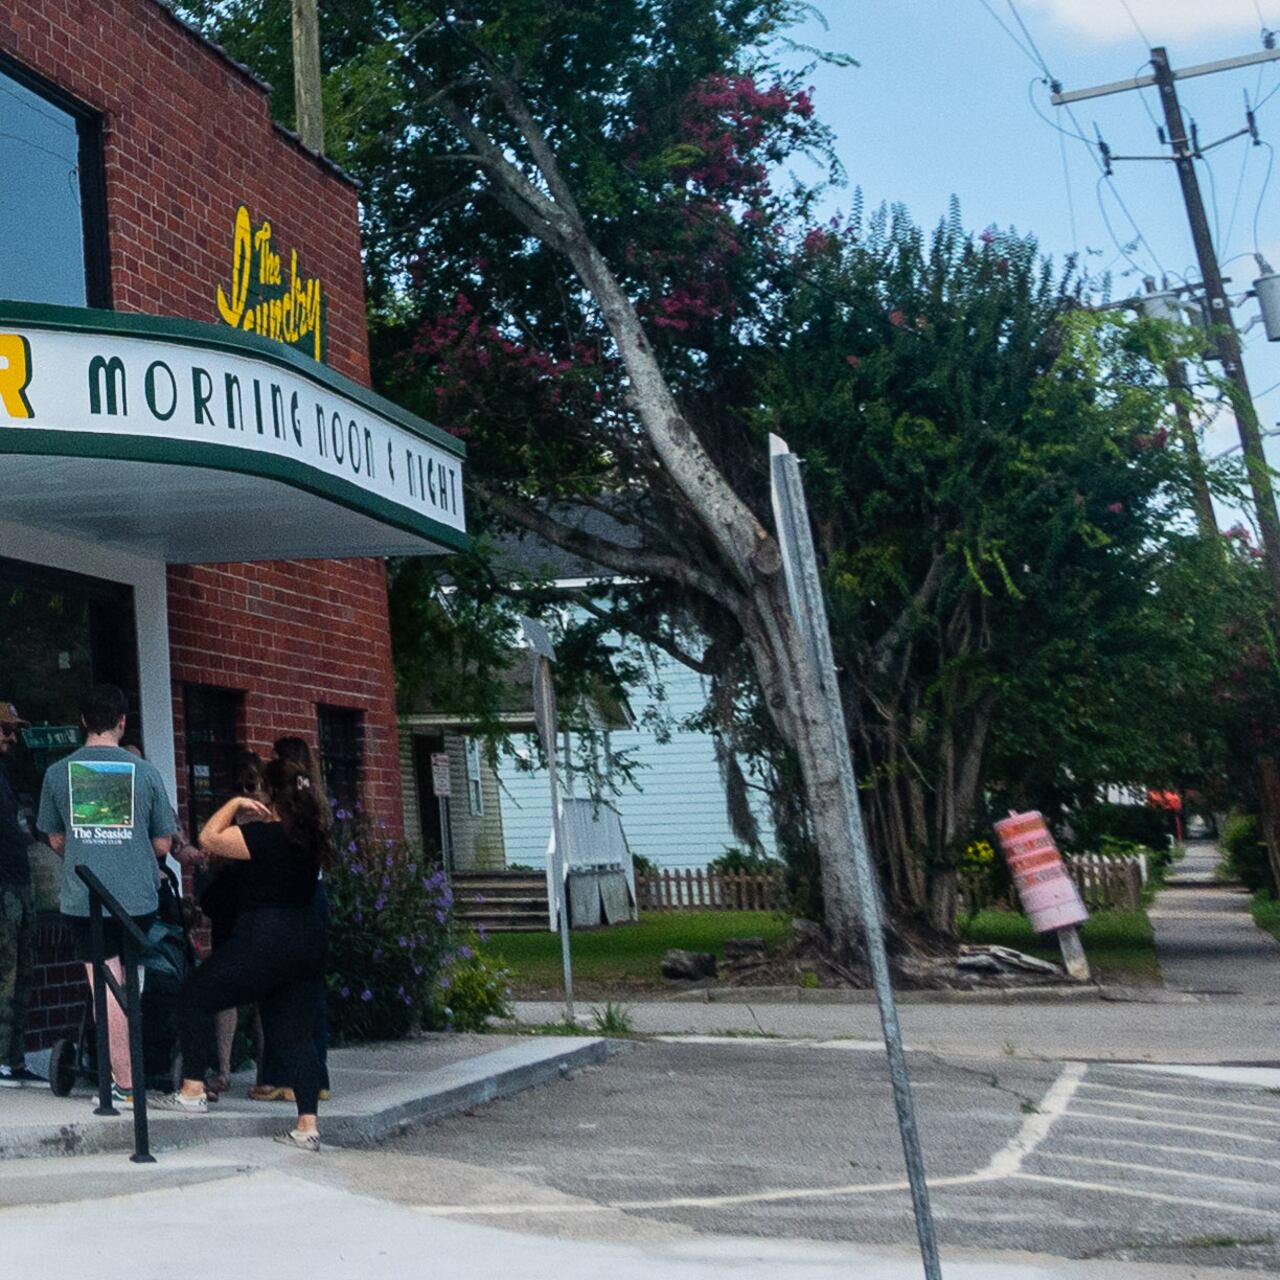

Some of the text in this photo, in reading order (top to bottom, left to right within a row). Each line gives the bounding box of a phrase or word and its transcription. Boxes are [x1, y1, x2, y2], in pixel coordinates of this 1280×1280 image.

[255, 221, 282, 285] The
[88, 355, 303, 447] MORNING
[315, 403, 375, 479] NOON
[406, 449, 457, 516] NIGHT
[72, 828, 133, 840] The Seaside
